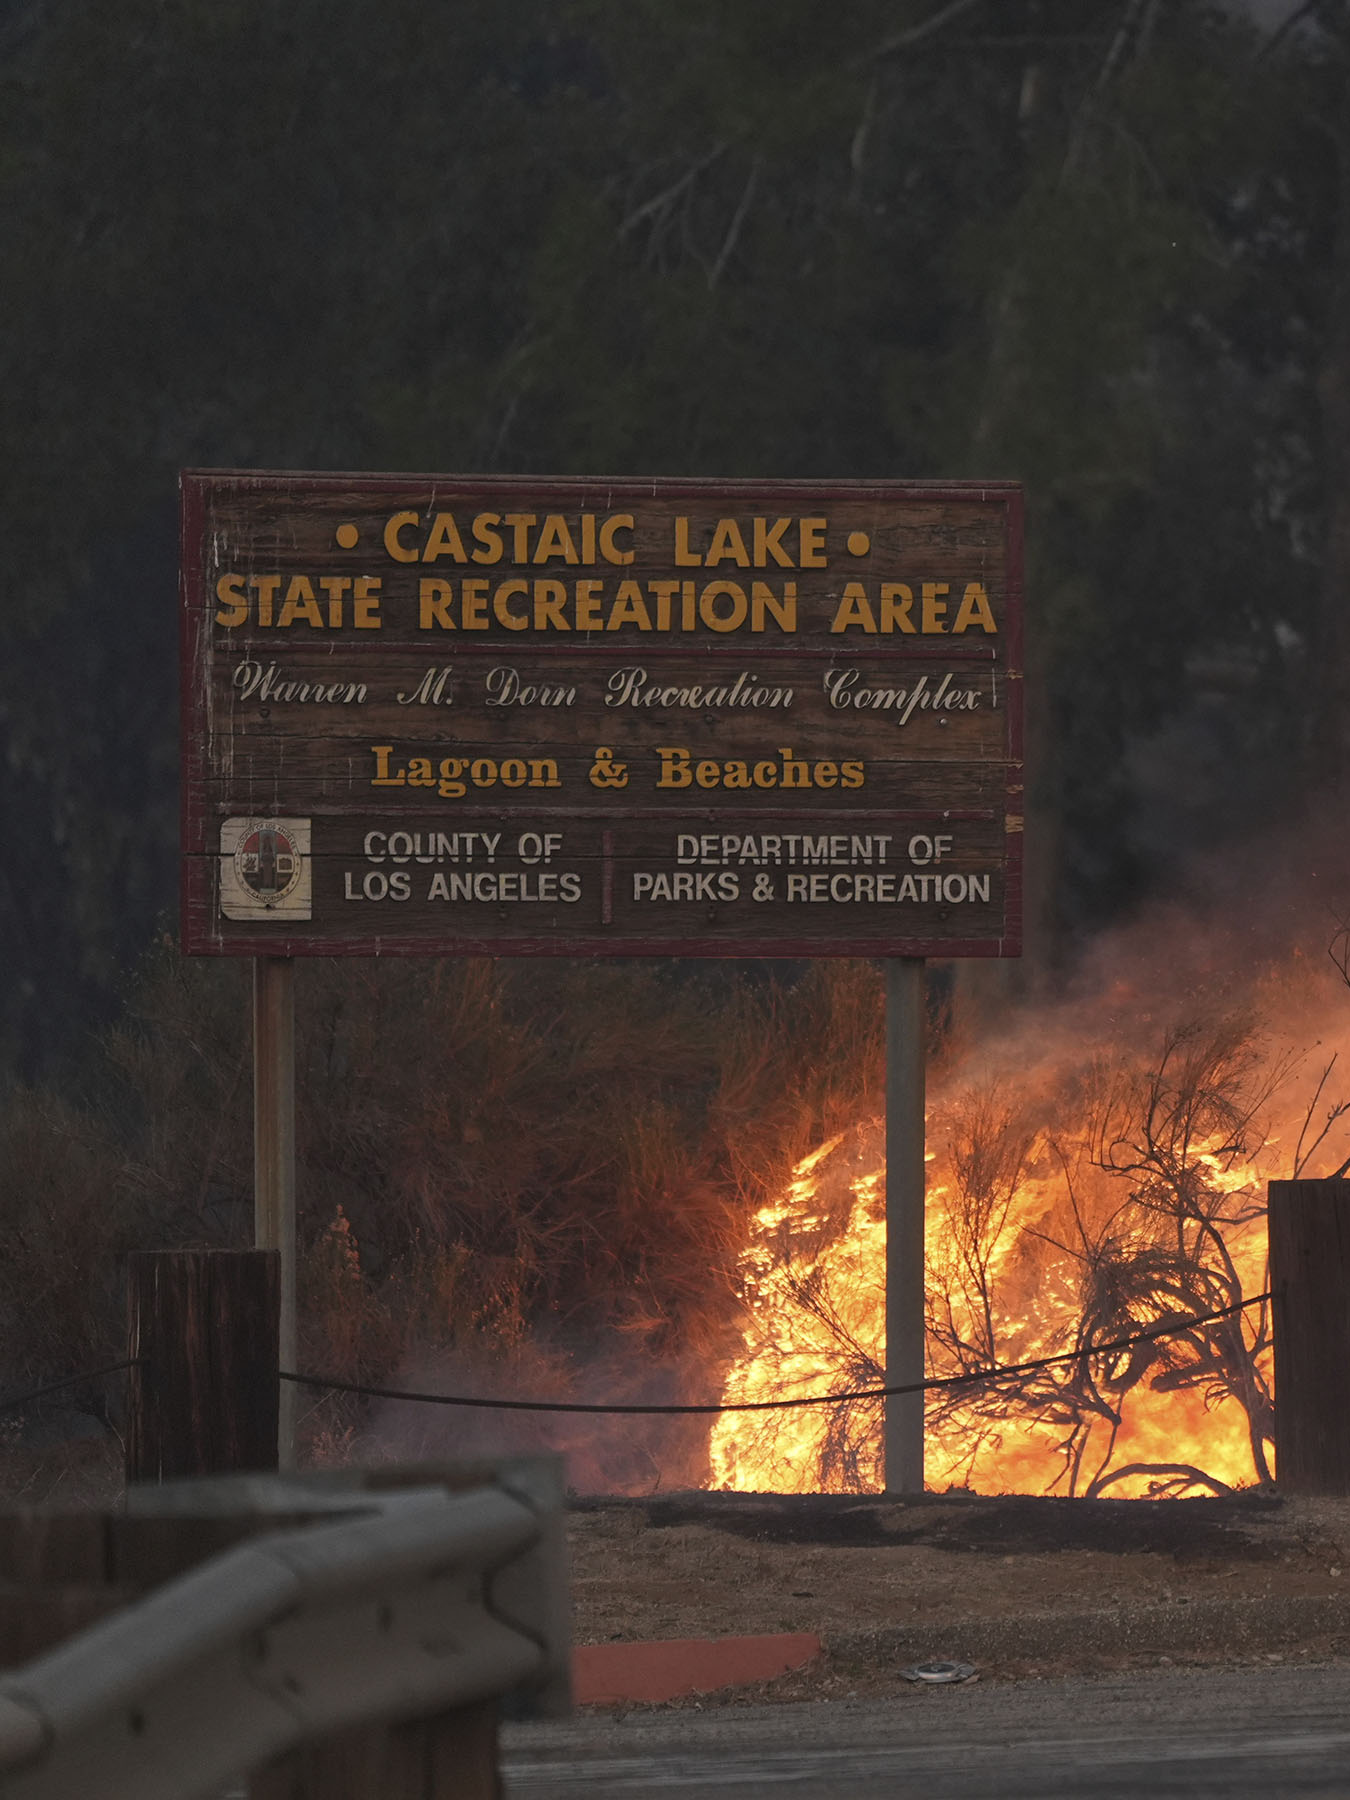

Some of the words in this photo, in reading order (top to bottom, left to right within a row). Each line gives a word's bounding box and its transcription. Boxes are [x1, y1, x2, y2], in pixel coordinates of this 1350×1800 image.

[384, 511, 635, 565] CASTAIC
[675, 516, 828, 568] LAKE
[215, 573, 382, 629] STATE
[419, 578, 797, 633] RECREATION
[830, 581, 998, 635] AREA
[233, 660, 367, 704] Warren
[397, 665, 453, 705] M.
[485, 665, 576, 706] Dorn
[605, 665, 794, 708] Recreation
[824, 668, 981, 725] Complex
[370, 745, 562, 798] Lagoon
[589, 747, 628, 788] &
[656, 747, 865, 788] Beaches
[363, 831, 501, 864] COUNTY
[518, 832, 563, 865] OF
[677, 834, 893, 865] DEPARTMENT
[908, 835, 953, 865] OF
[345, 871, 411, 901] LOS
[427, 872, 582, 902] ANGELES
[633, 872, 740, 902] PARKS
[752, 873, 775, 902] &
[787, 874, 990, 903] RECREATION
